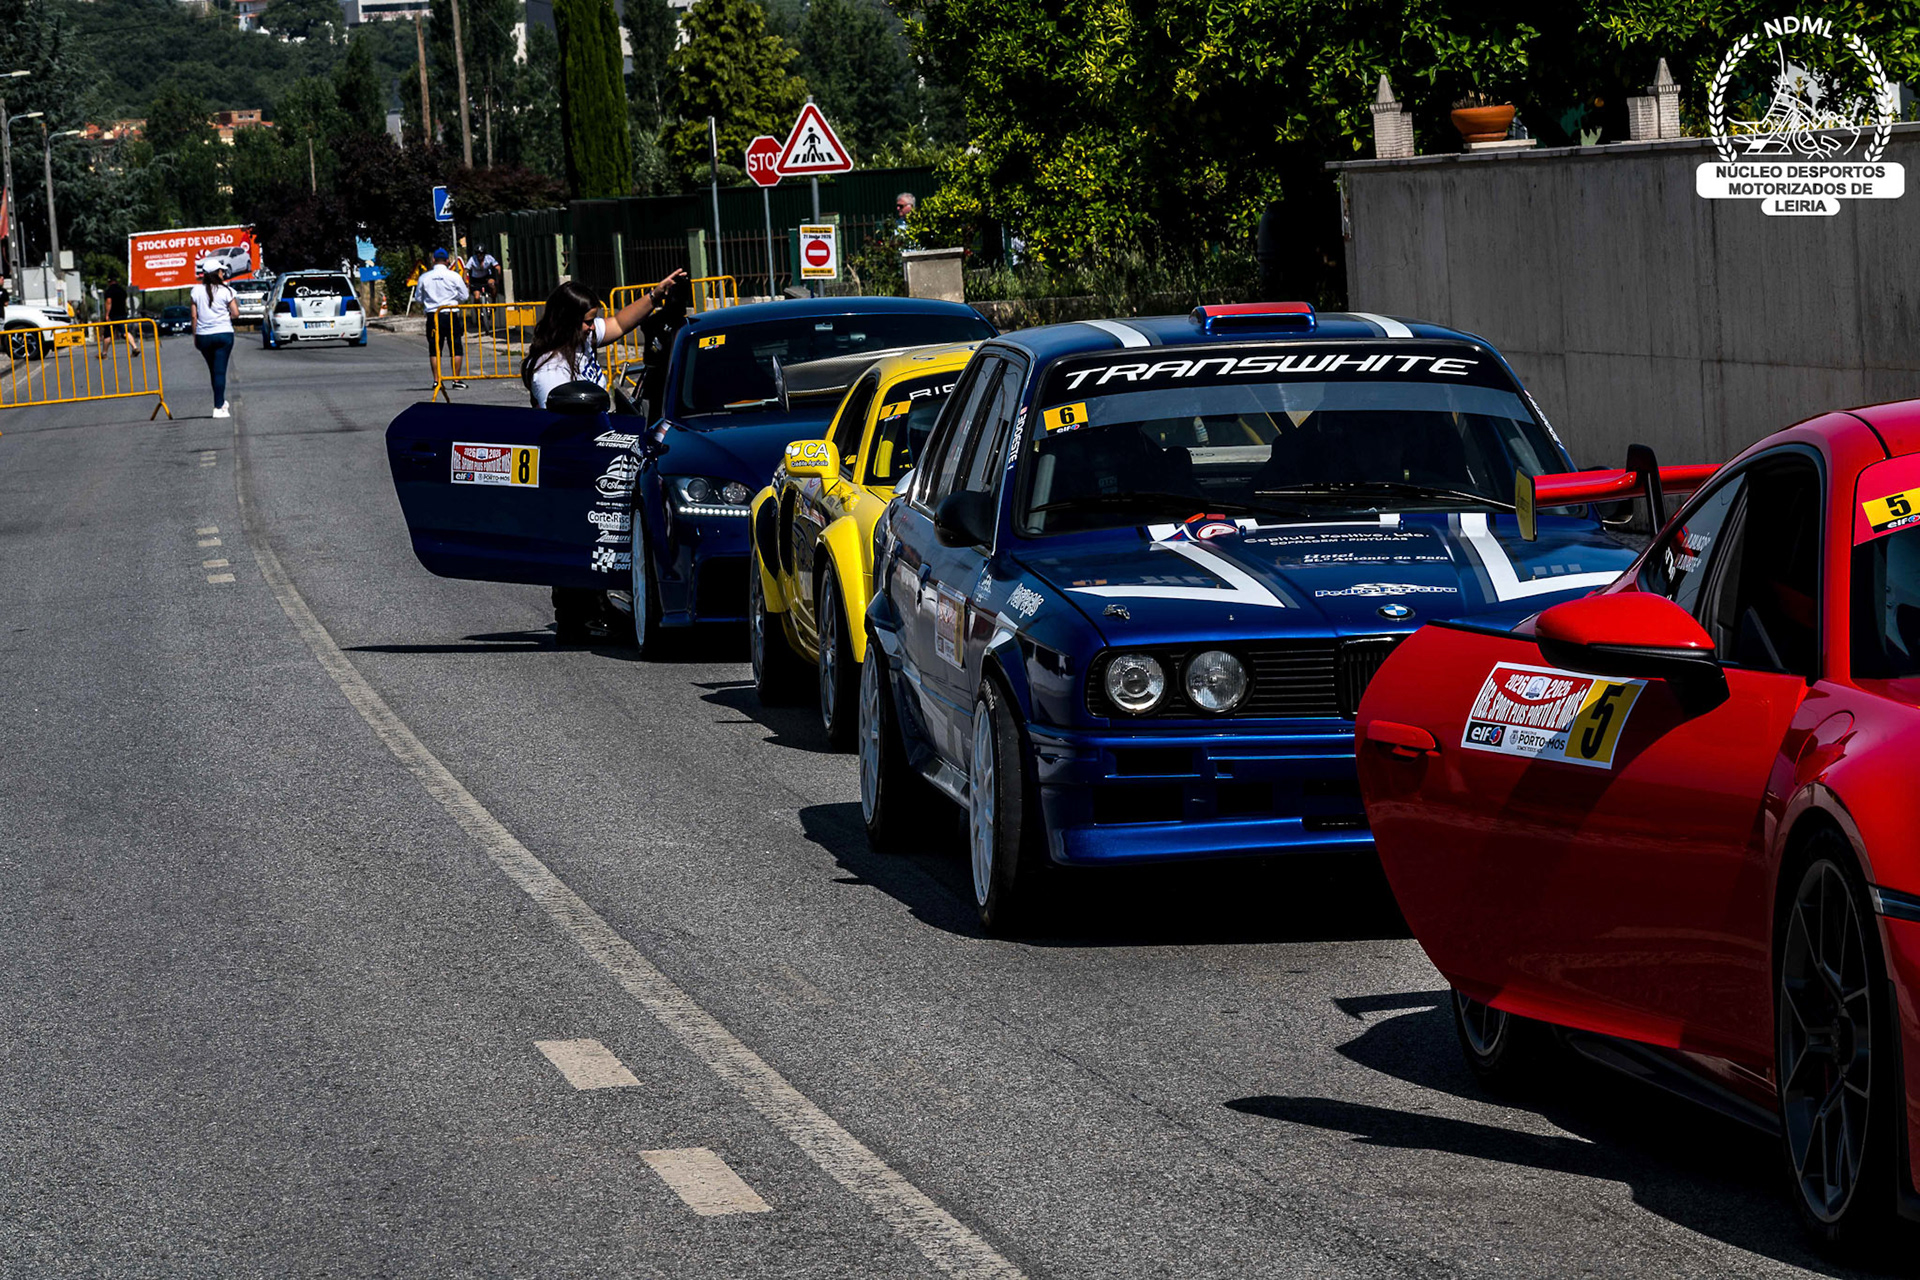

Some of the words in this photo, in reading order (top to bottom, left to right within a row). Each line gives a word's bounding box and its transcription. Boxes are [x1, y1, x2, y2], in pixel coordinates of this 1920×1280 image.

[136, 240, 168, 251] STOCK
[168, 238, 186, 248] OFF
[188, 237, 201, 247] DE
[201, 234, 234, 246] VERÃO
[1065, 355, 1480, 391] TRANSWHITE
[890, 404, 898, 416] 7
[1059, 407, 1075, 425] 6
[1056, 426, 1071, 434] elf
[803, 443, 829, 458] CA
[518, 449, 530, 484] 8
[1885, 493, 1912, 517] 5
[1887, 518, 1908, 529] elf
[1315, 588, 1374, 597] Pedro
[1378, 585, 1458, 594] Ferreira
[1505, 674, 1530, 696] 2026
[1545, 679, 1573, 699] 2026
[1488, 691, 1514, 723] SPORT
[1508, 702, 1529, 725] PLUS
[1524, 701, 1554, 728] PORTO
[1546, 697, 1566, 728] DE
[1581, 684, 1626, 759] 5
[1471, 726, 1491, 742] elf
